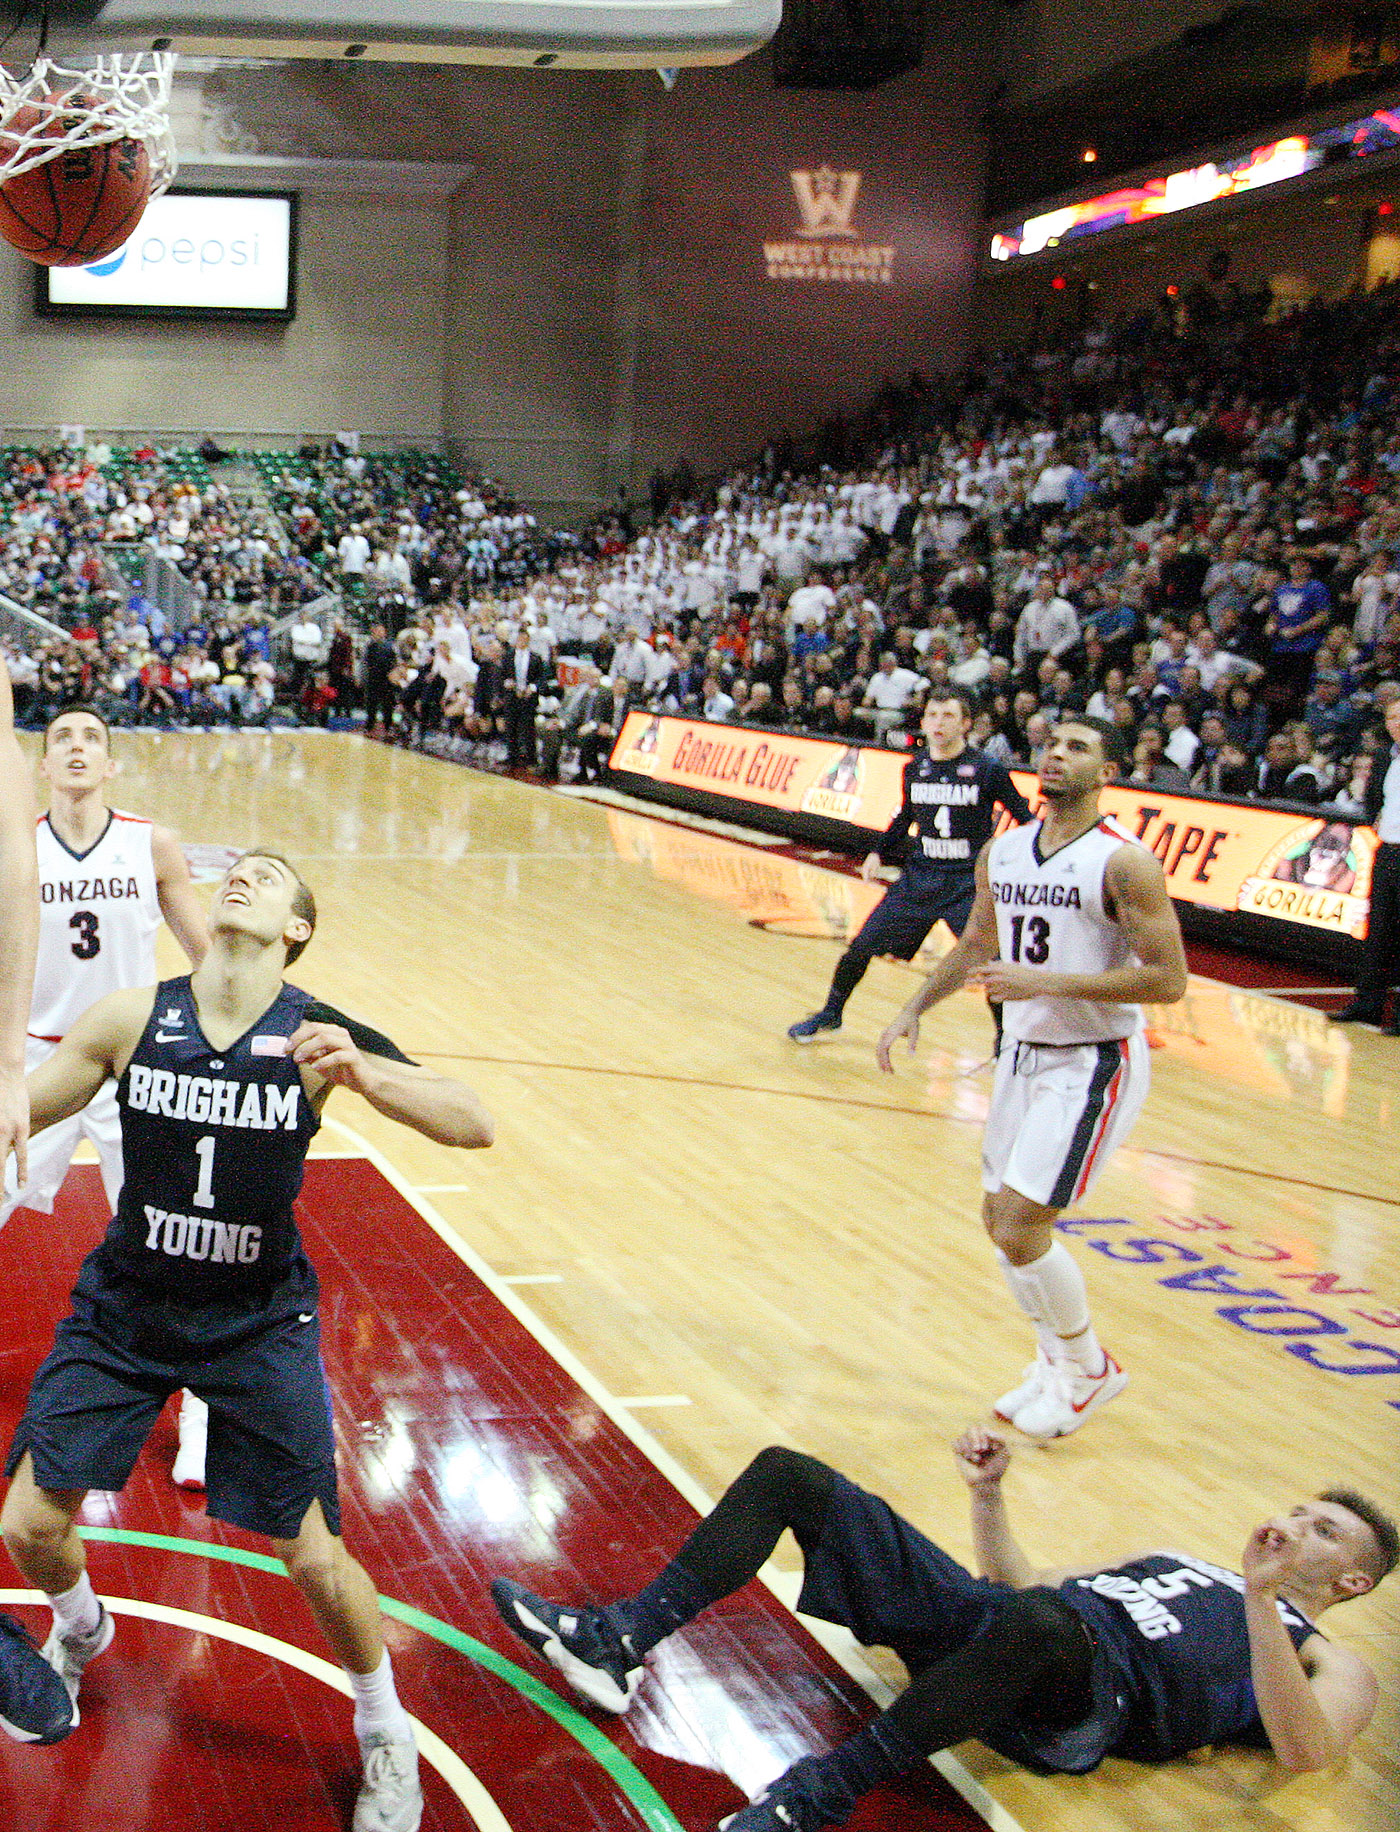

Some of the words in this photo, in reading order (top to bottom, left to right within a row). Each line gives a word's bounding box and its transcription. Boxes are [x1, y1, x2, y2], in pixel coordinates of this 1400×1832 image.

[141, 232, 259, 273] pepsi
[673, 731, 747, 783] GORILLA
[746, 743, 799, 794] GLUE
[934, 805, 951, 839] 4
[1137, 807, 1229, 883] TAPE
[41, 876, 140, 904] ONZAGA
[1254, 888, 1345, 923] GORILLA
[69, 910, 101, 960] 3
[1010, 915, 1051, 965] 13
[127, 1063, 301, 1131] BRIGHAM
[193, 1135, 216, 1209] 1
[143, 1204, 263, 1264] YOUNG
